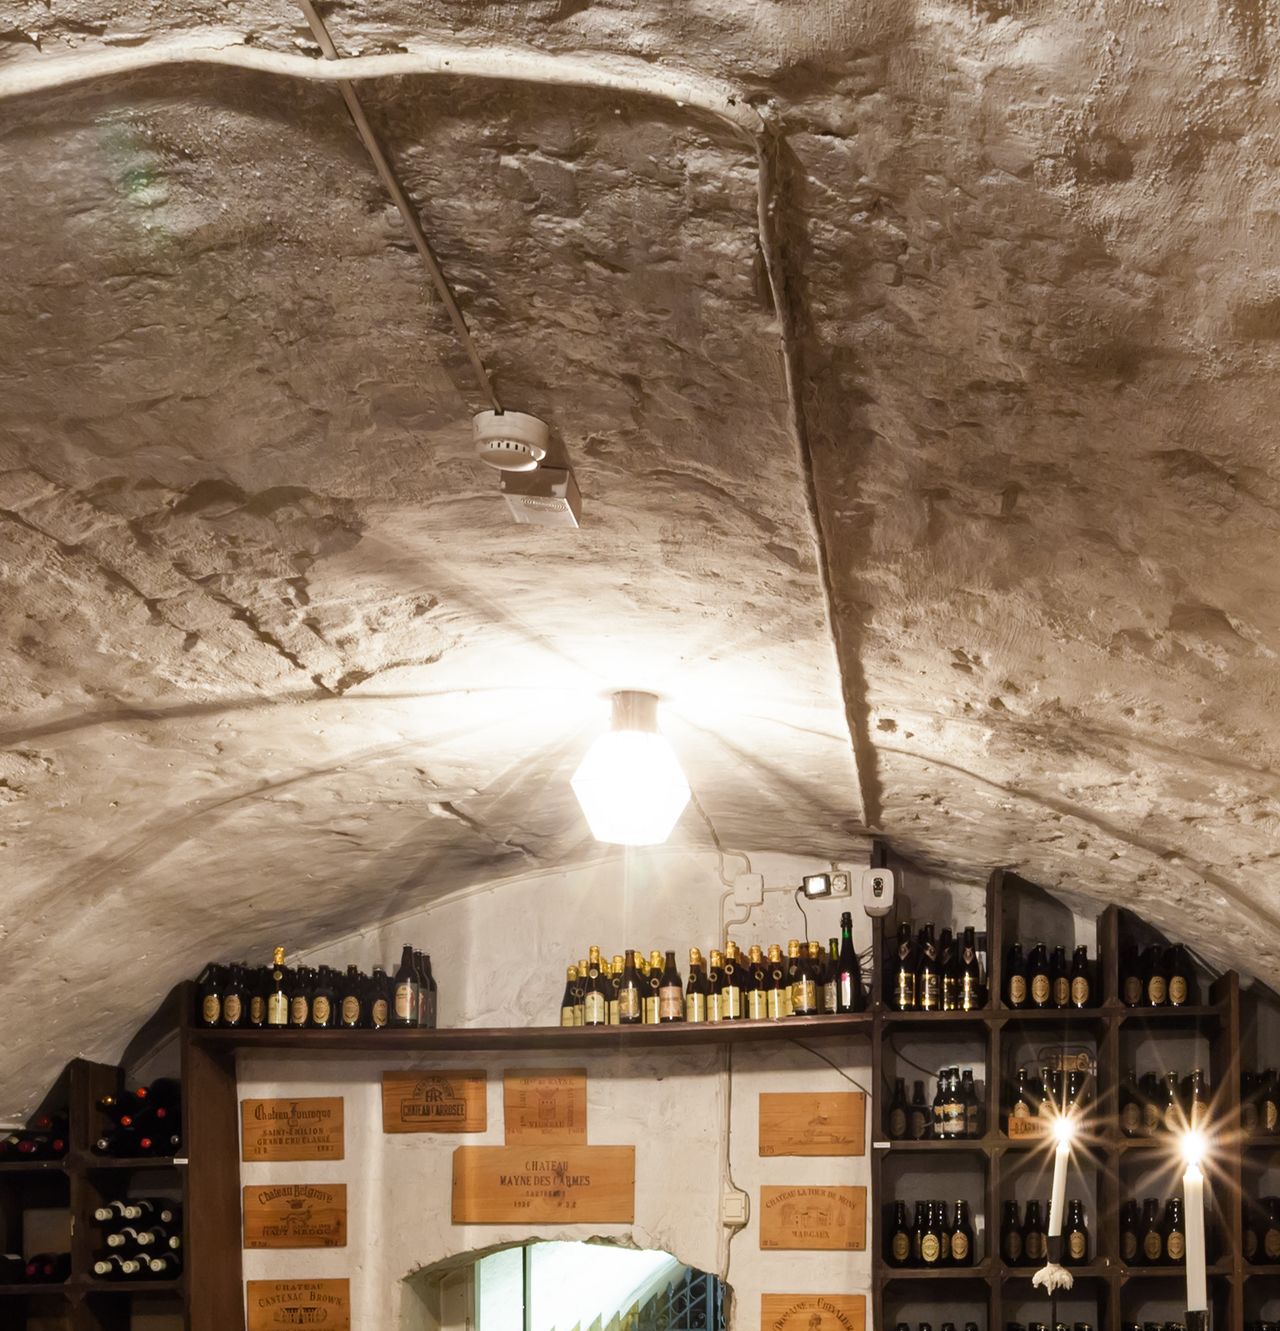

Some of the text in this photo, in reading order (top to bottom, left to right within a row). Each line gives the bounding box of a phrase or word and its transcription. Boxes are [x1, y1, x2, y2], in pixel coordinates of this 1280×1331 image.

[525, 1160, 569, 1172] CHATEAU
[499, 1175, 531, 1187] MAYNE
[533, 1175, 551, 1186] DES
